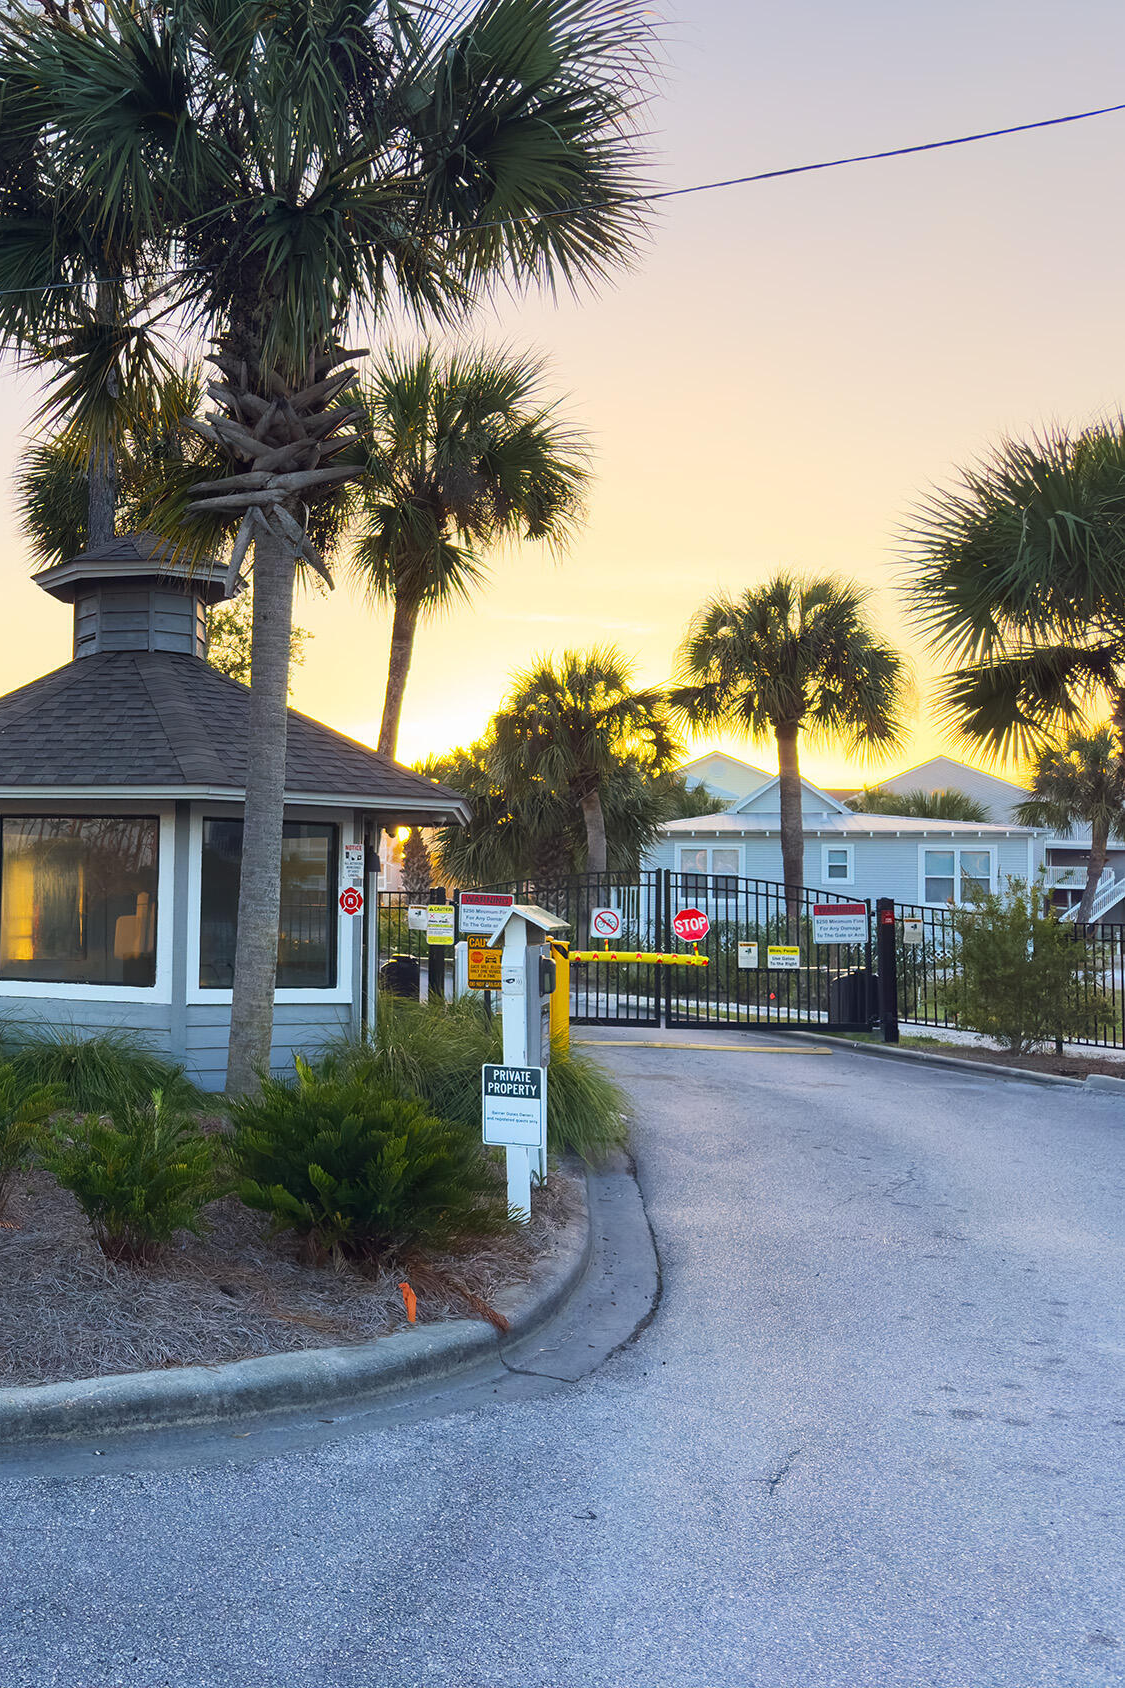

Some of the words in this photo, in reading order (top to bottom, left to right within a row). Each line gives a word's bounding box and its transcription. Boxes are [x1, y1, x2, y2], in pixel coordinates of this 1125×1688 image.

[466, 895, 509, 904] WARNING
[675, 917, 706, 933] STOP
[493, 1070, 531, 1082] PRIVATE
[487, 1082, 537, 1096] PROPERTY
